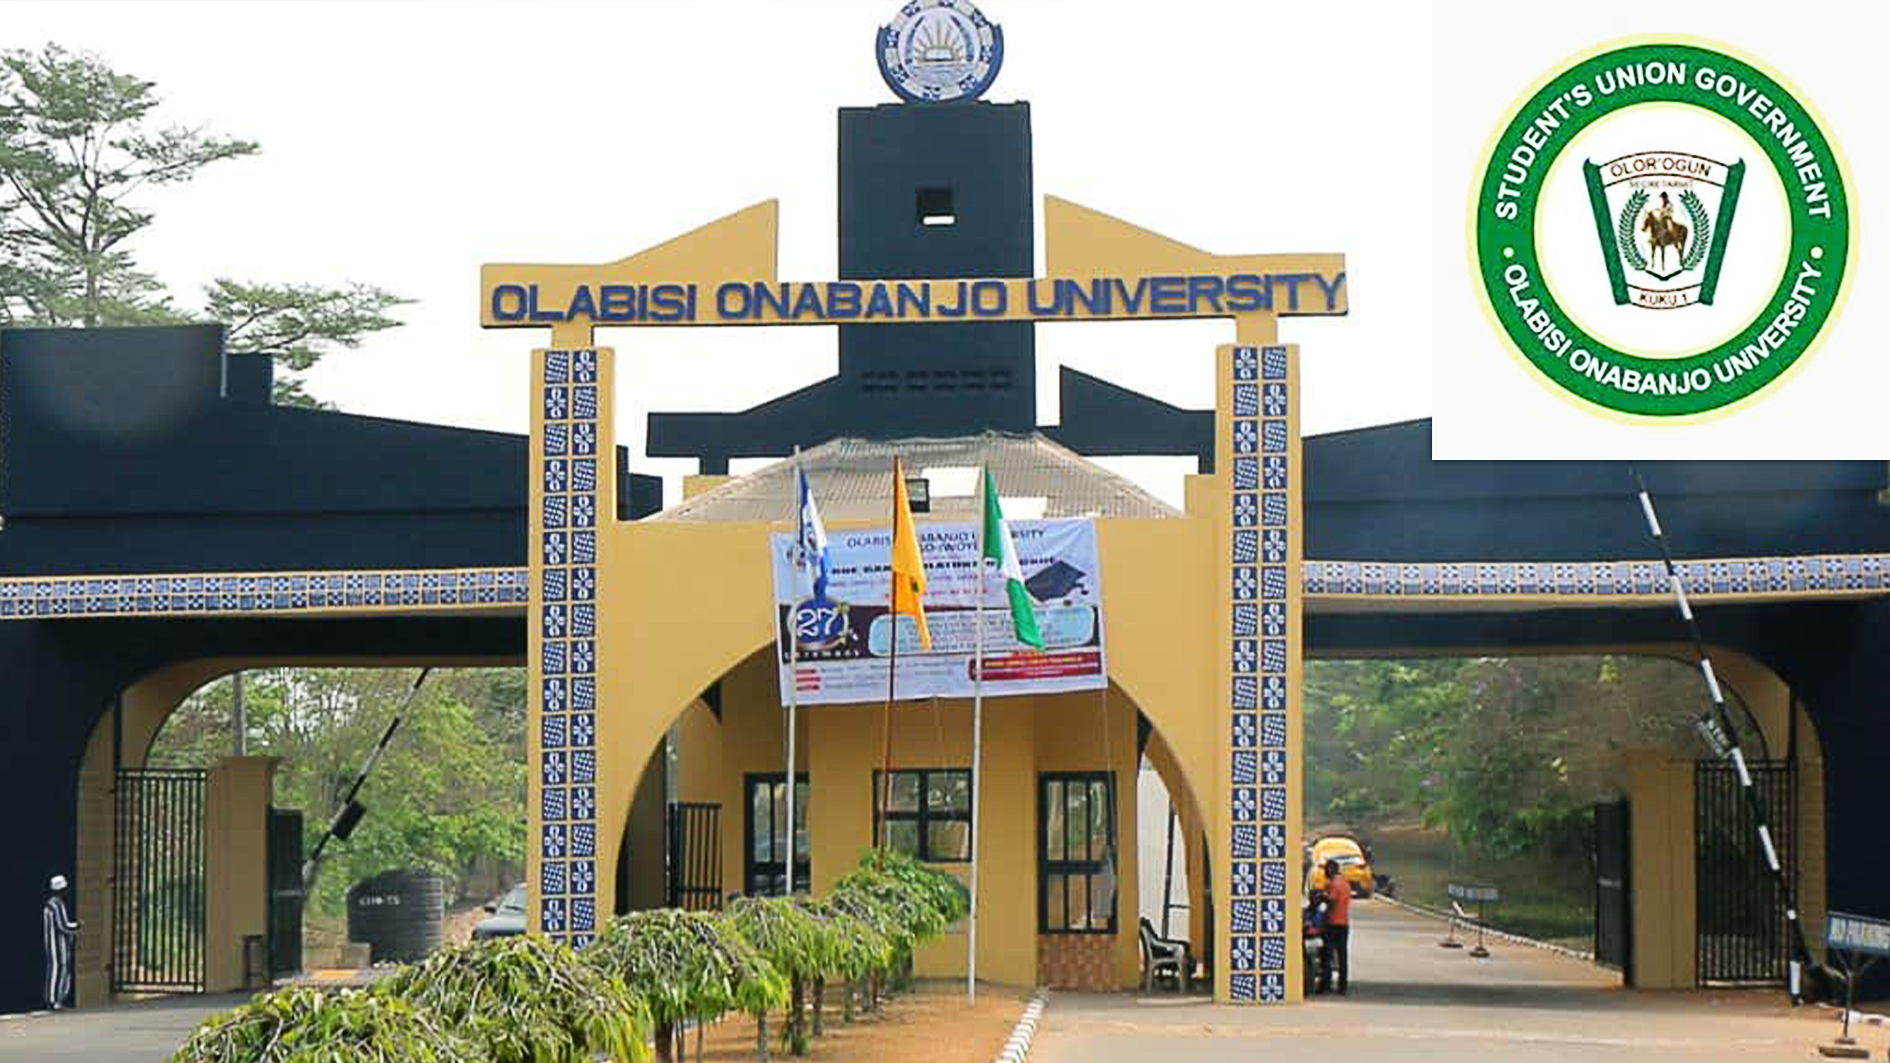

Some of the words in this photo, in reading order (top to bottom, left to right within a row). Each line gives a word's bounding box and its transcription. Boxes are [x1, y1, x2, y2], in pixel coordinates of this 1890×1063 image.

[492, 283, 697, 321] OLABISI
[716, 279, 1008, 320] ONABANJO
[1028, 271, 1347, 317] UNIVERSITY
[847, 535, 893, 549] OLABIS
[797, 607, 838, 638] 27
